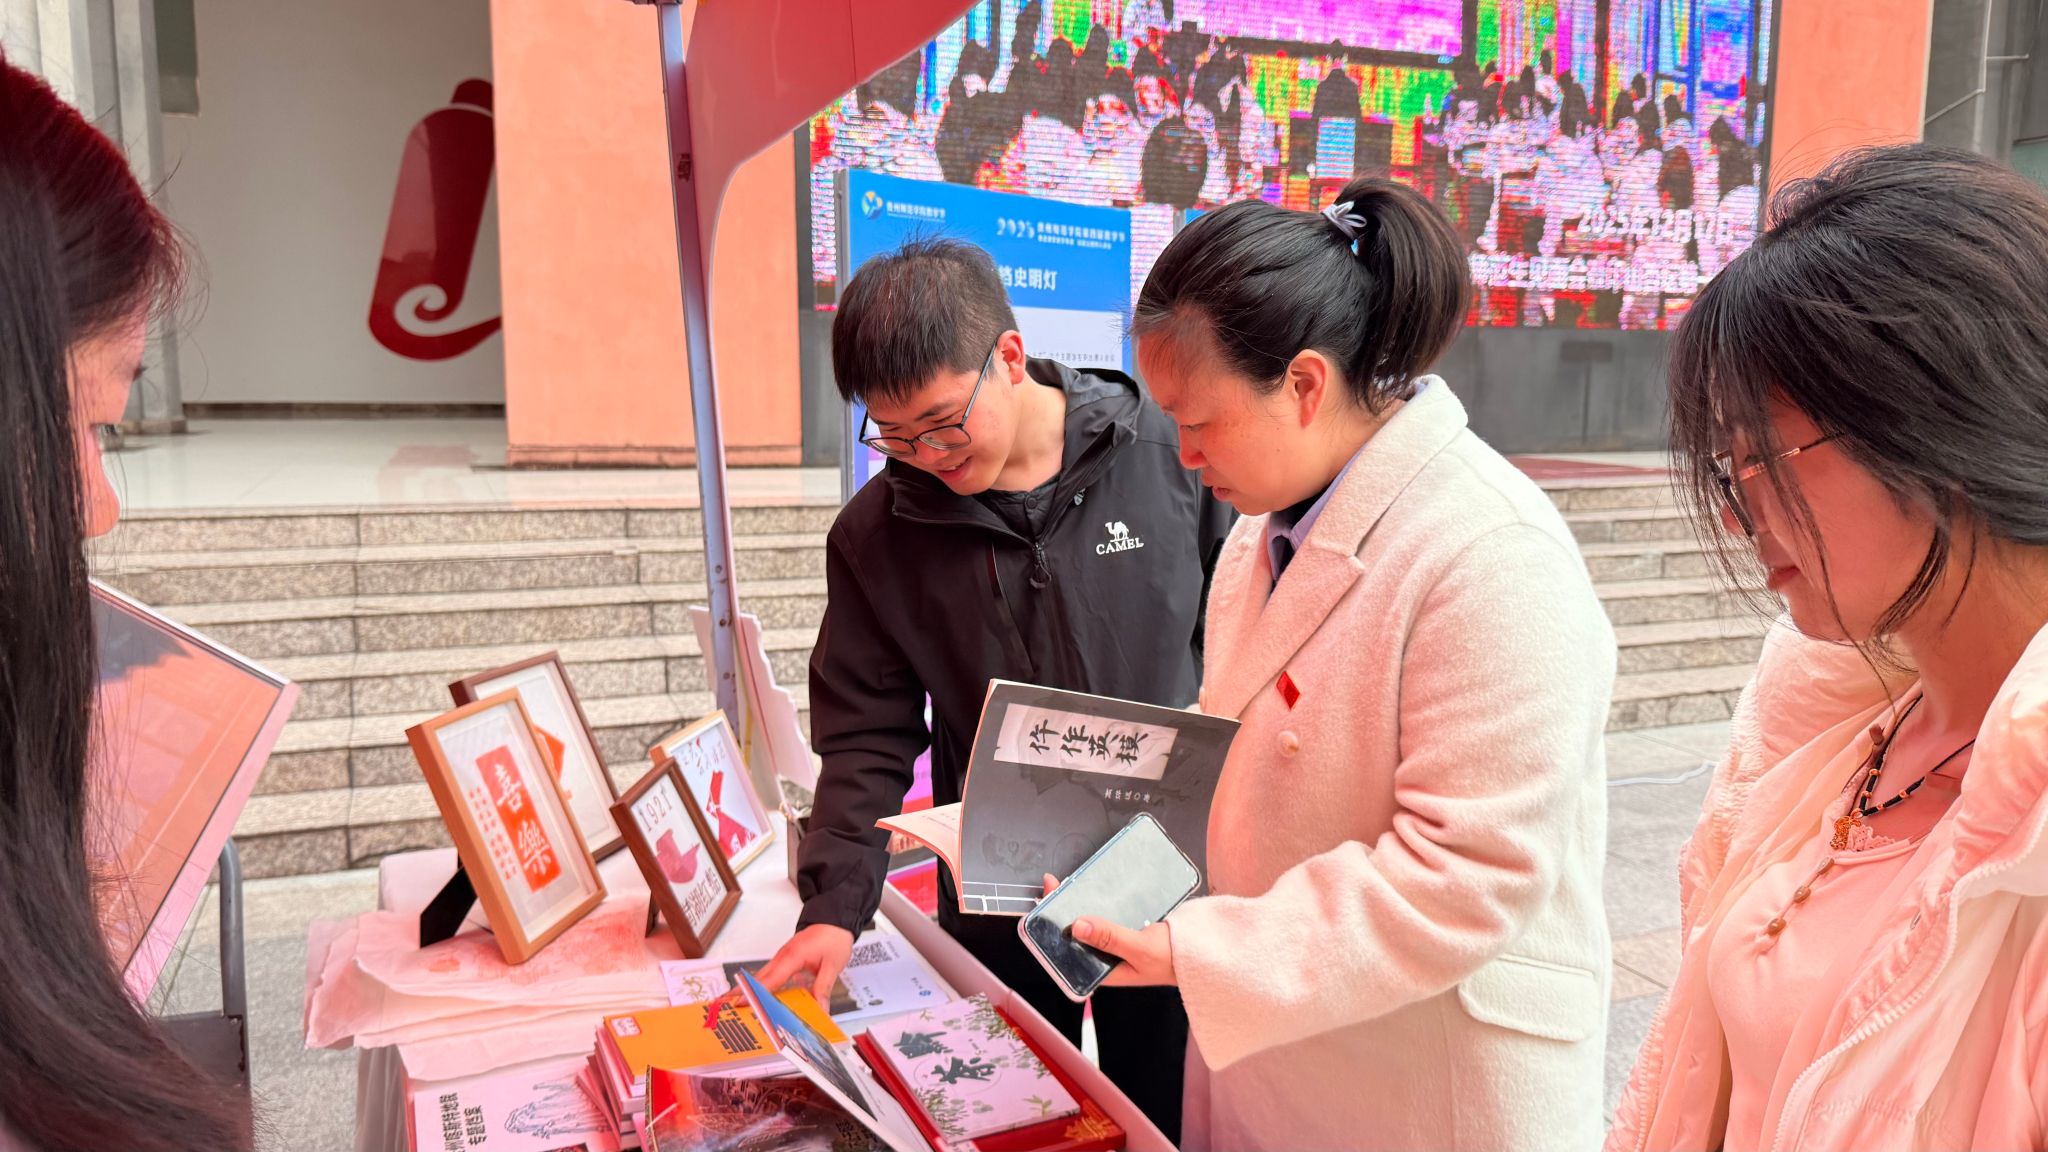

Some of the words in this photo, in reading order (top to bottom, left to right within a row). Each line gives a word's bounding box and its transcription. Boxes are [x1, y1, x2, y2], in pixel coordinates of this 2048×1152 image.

[1095, 537, 1145, 556] CAMEL
[1028, 718, 1149, 768] 仵作英模
[638, 783, 673, 833] 1921
